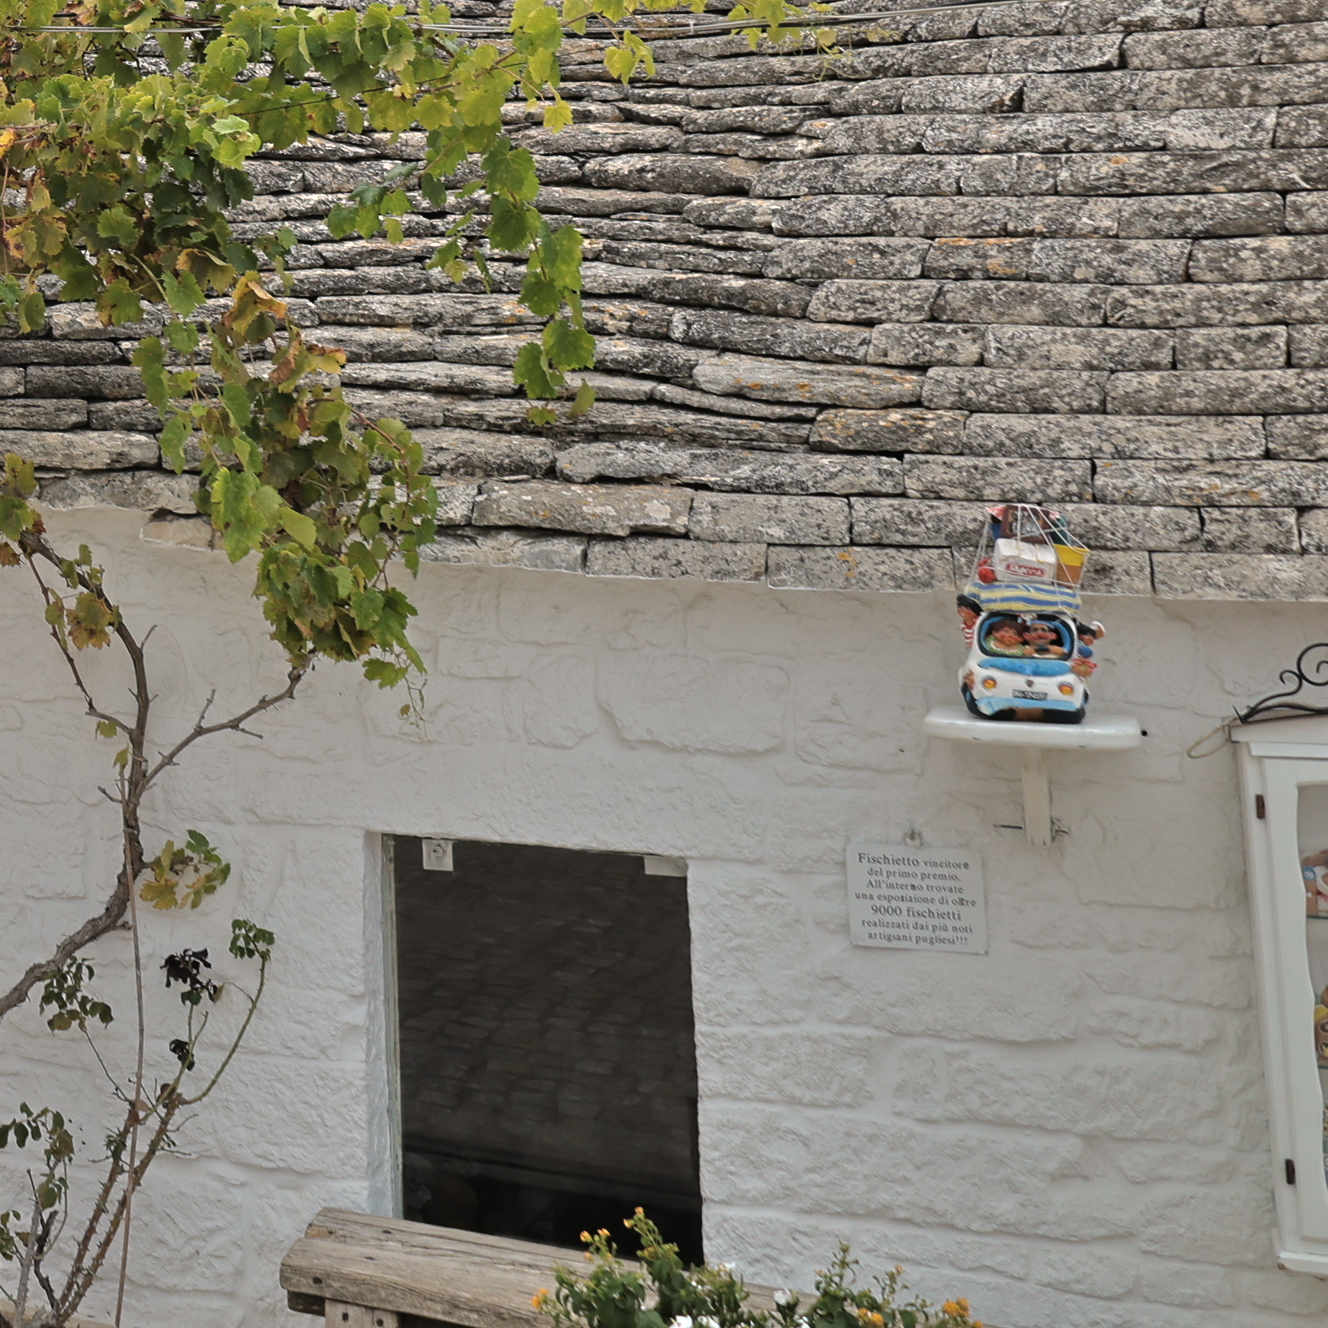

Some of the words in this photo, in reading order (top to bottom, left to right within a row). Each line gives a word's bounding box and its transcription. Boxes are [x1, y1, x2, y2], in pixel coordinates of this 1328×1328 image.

[858, 852, 920, 867] Fischietto
[924, 857, 969, 870] vincitore
[867, 867, 884, 877] del
[886, 869, 918, 880] primo
[855, 891, 874, 900] una
[938, 895, 949, 905] di
[871, 903, 902, 917] 9000
[906, 907, 961, 921] fischietti
[862, 919, 909, 930] realizzati
[912, 920, 929, 931] dai
[867, 931, 912, 943] artigiani
